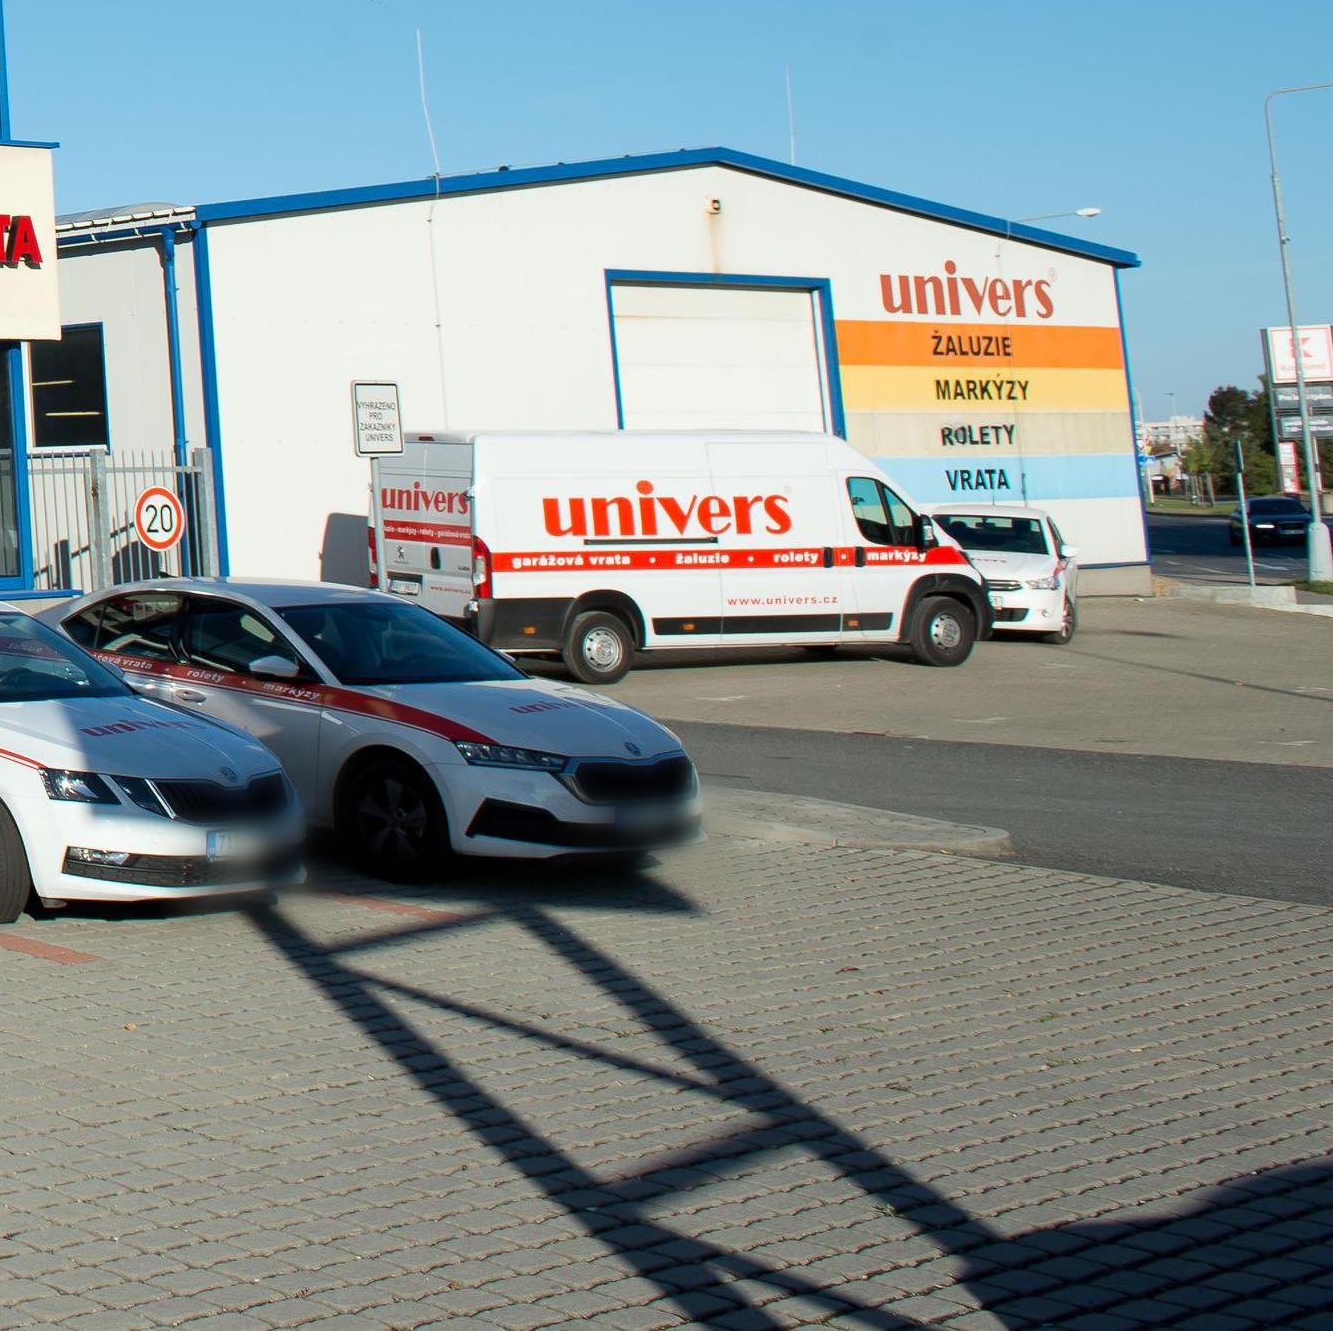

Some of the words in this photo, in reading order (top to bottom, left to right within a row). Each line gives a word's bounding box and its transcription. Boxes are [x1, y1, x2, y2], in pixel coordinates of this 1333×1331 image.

[880, 260, 1054, 319] univers
[931, 330, 1014, 357] ŽALUZIE
[935, 373, 1030, 401] MARKÝZY
[369, 412, 383, 420] PRO
[365, 433, 394, 442] UNIVERS
[941, 424, 1016, 446] ROLETY
[945, 469, 1011, 491] VRATA
[380, 481, 469, 515] univers
[542, 480, 793, 537] univers
[145, 504, 173, 533] 20
[512, 554, 584, 569] garážová
[589, 552, 631, 566] vrata
[675, 552, 730, 565] žaluzie
[773, 551, 819, 565] rolety
[866, 549, 927, 563] markýzy
[726, 595, 838, 605] www.univers.cz
[186, 668, 226, 683] rolety
[262, 680, 320, 701] markýzy
